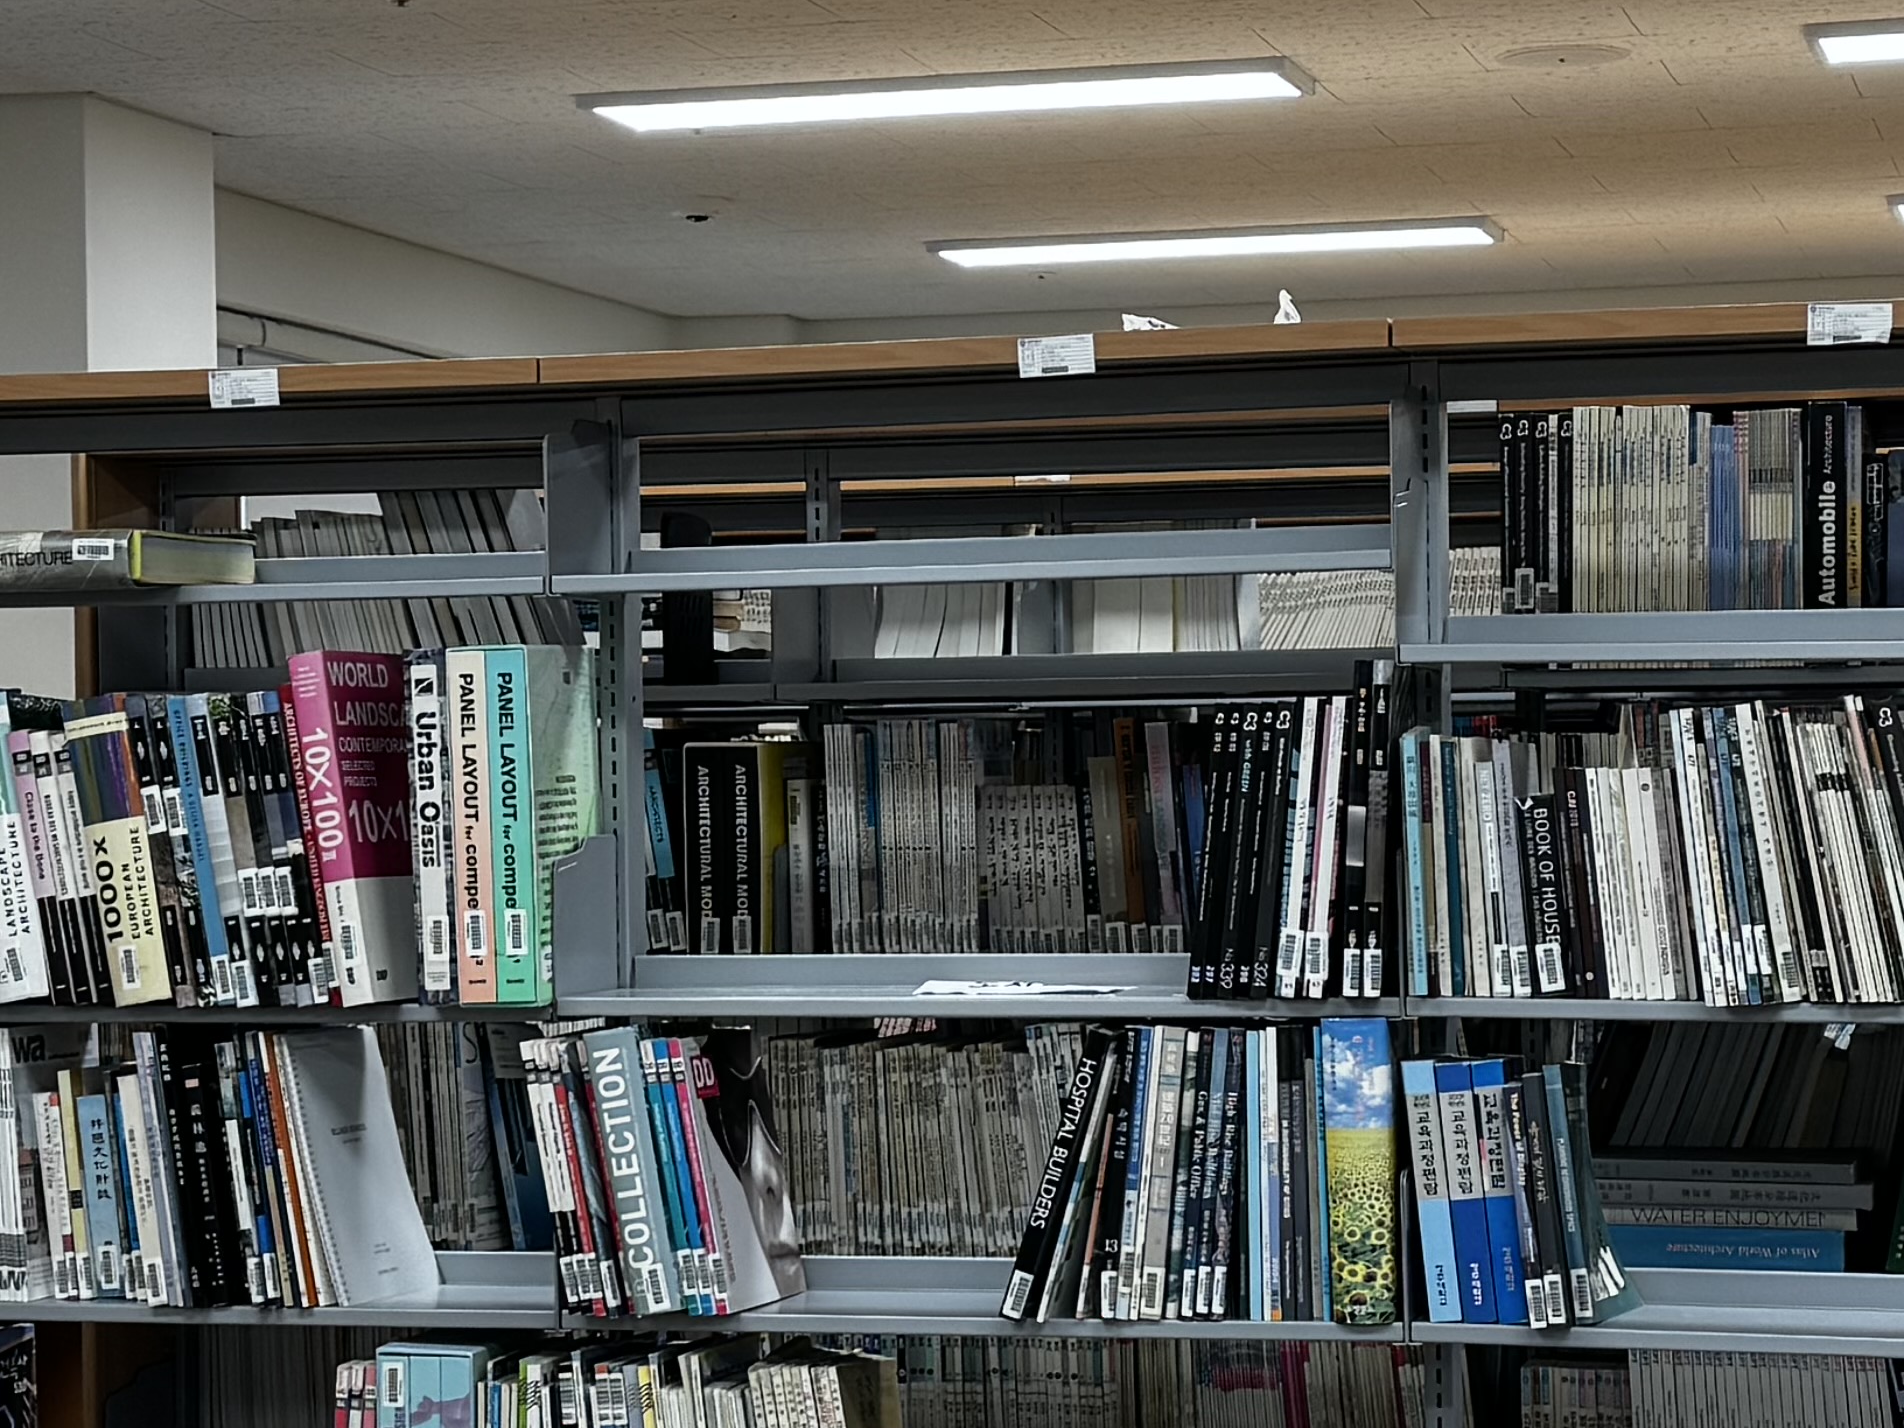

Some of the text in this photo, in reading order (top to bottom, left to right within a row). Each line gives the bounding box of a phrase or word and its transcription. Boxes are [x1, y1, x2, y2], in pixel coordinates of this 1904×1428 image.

[1818, 480, 1837, 606] Automobile
[327, 661, 388, 688] WORLD
[458, 673, 478, 737] PANEL
[496, 672, 514, 737] PANEL
[414, 710, 441, 869] Urban Oasis
[461, 743, 480, 823] LAYOUT
[499, 742, 518, 823] LAYOUT
[121, 862, 141, 939] EUROPEAN
[130, 826, 154, 936] ARCHITECTURE
[1533, 808, 1561, 944] BOOK OF HOUSE
[591, 1046, 654, 1266] COLLECTION
[1029, 1057, 1097, 1230] HOSPITAL BUILDERS
[1631, 1207, 1706, 1223] WATER
